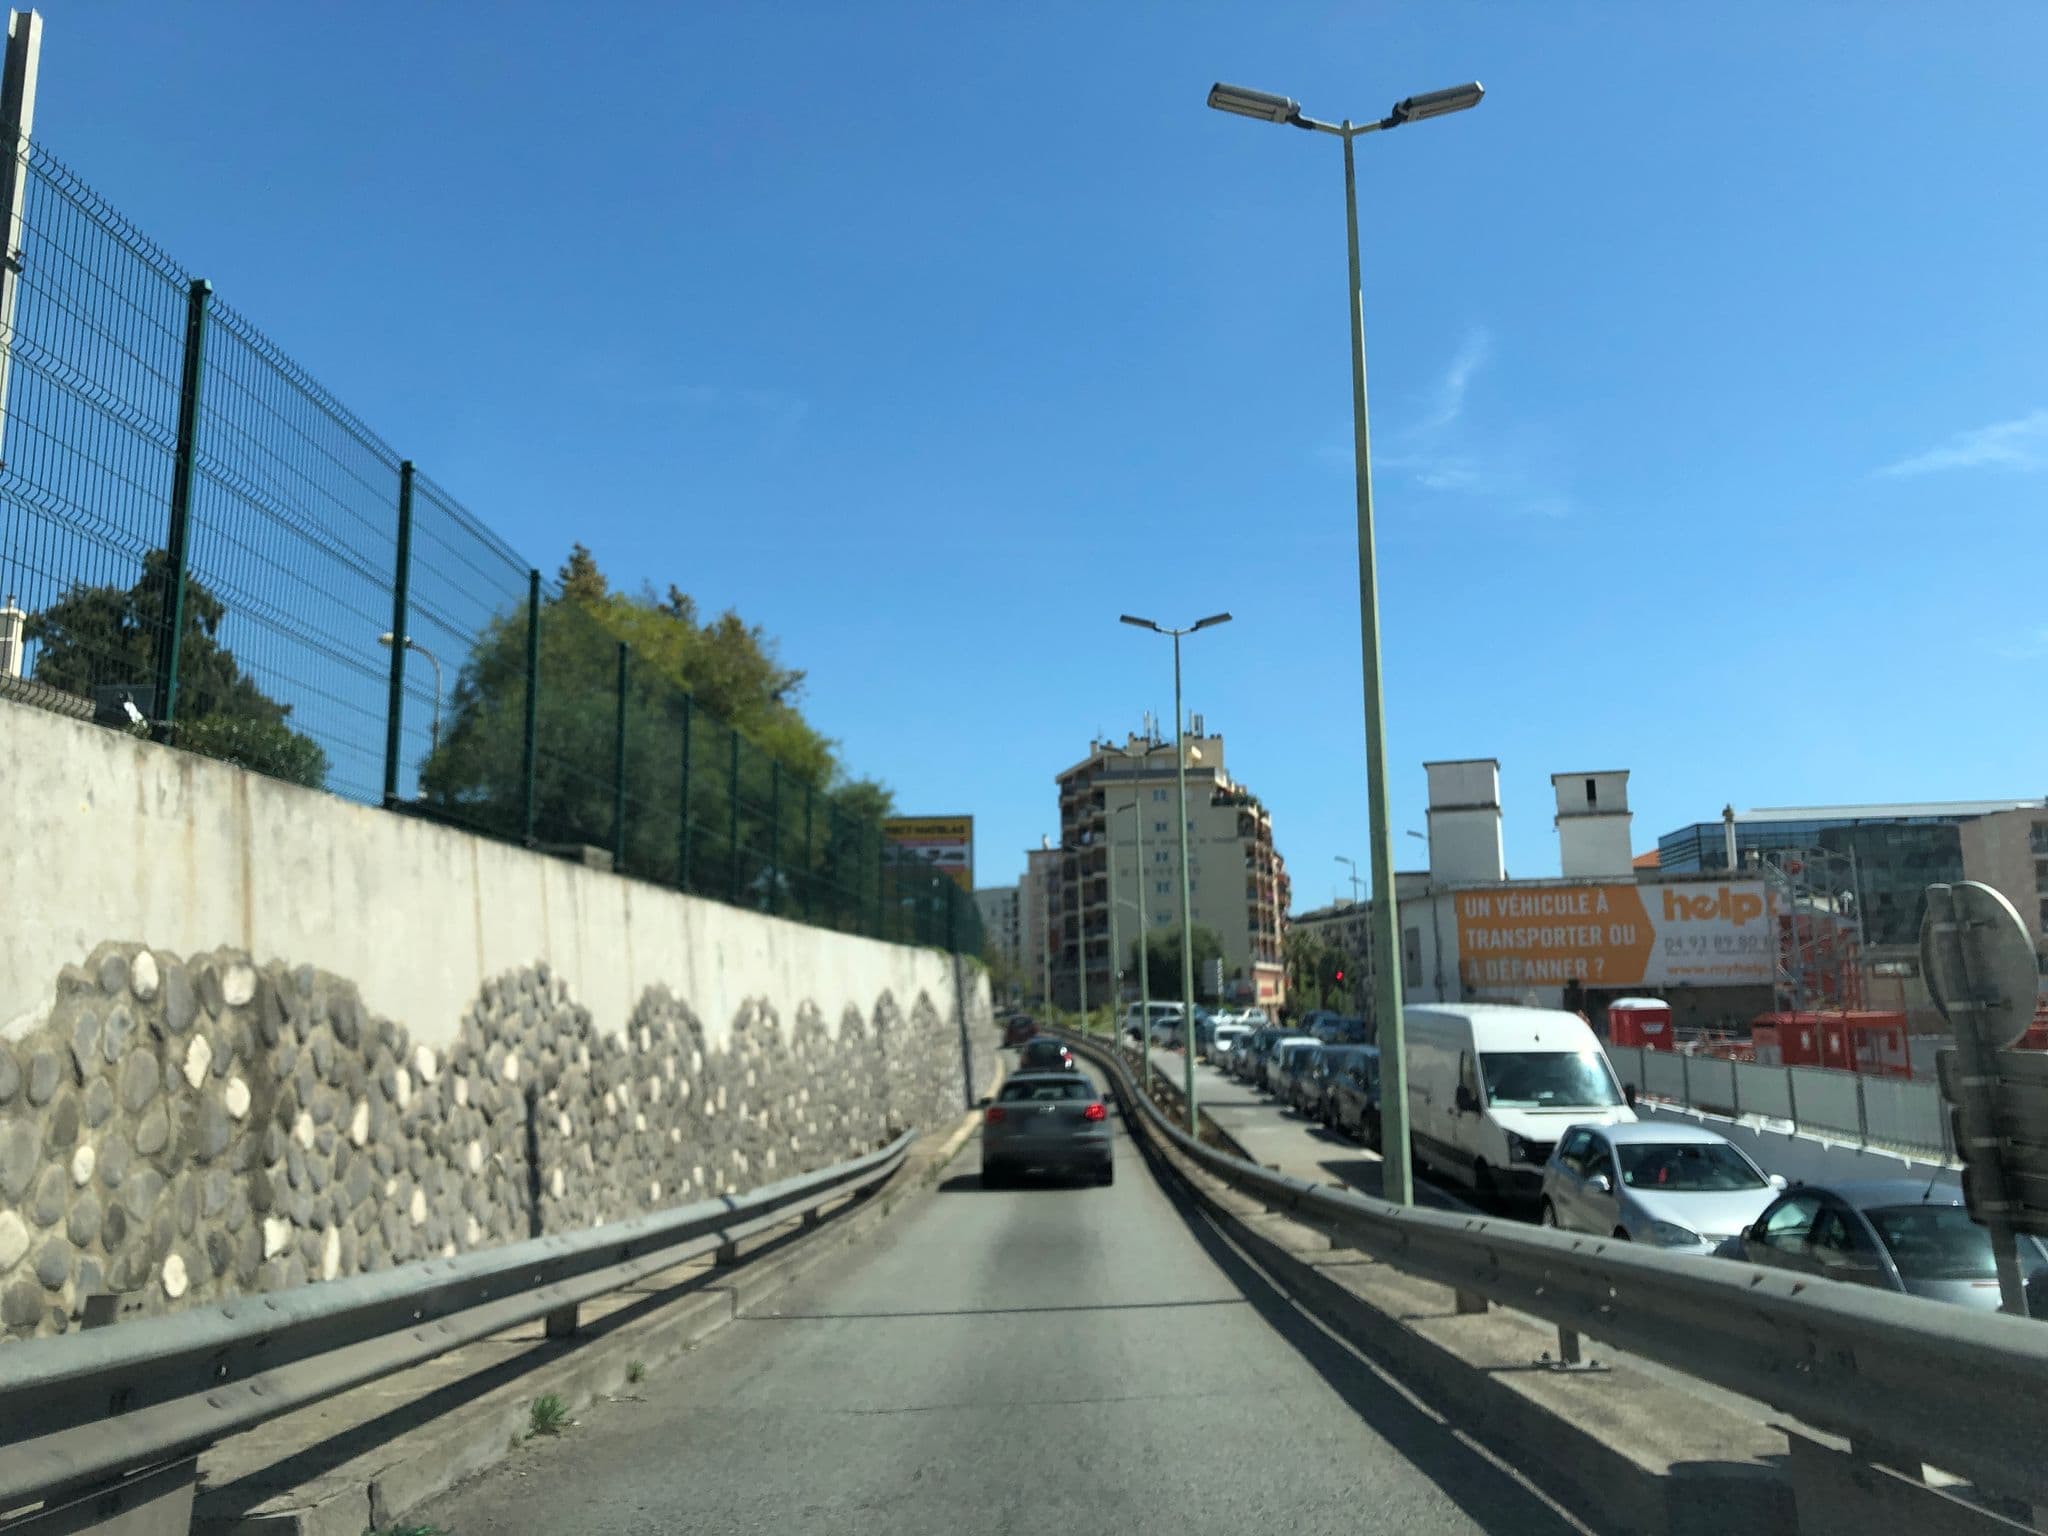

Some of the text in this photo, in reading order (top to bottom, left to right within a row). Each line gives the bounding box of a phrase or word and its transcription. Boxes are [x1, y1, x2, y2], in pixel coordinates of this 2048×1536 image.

[1464, 887, 1609, 918] UN VÉHICULE À
[1466, 923, 1637, 949] TRANSPORTER OU
[1468, 955, 1605, 981] À DÉPANNER ?
